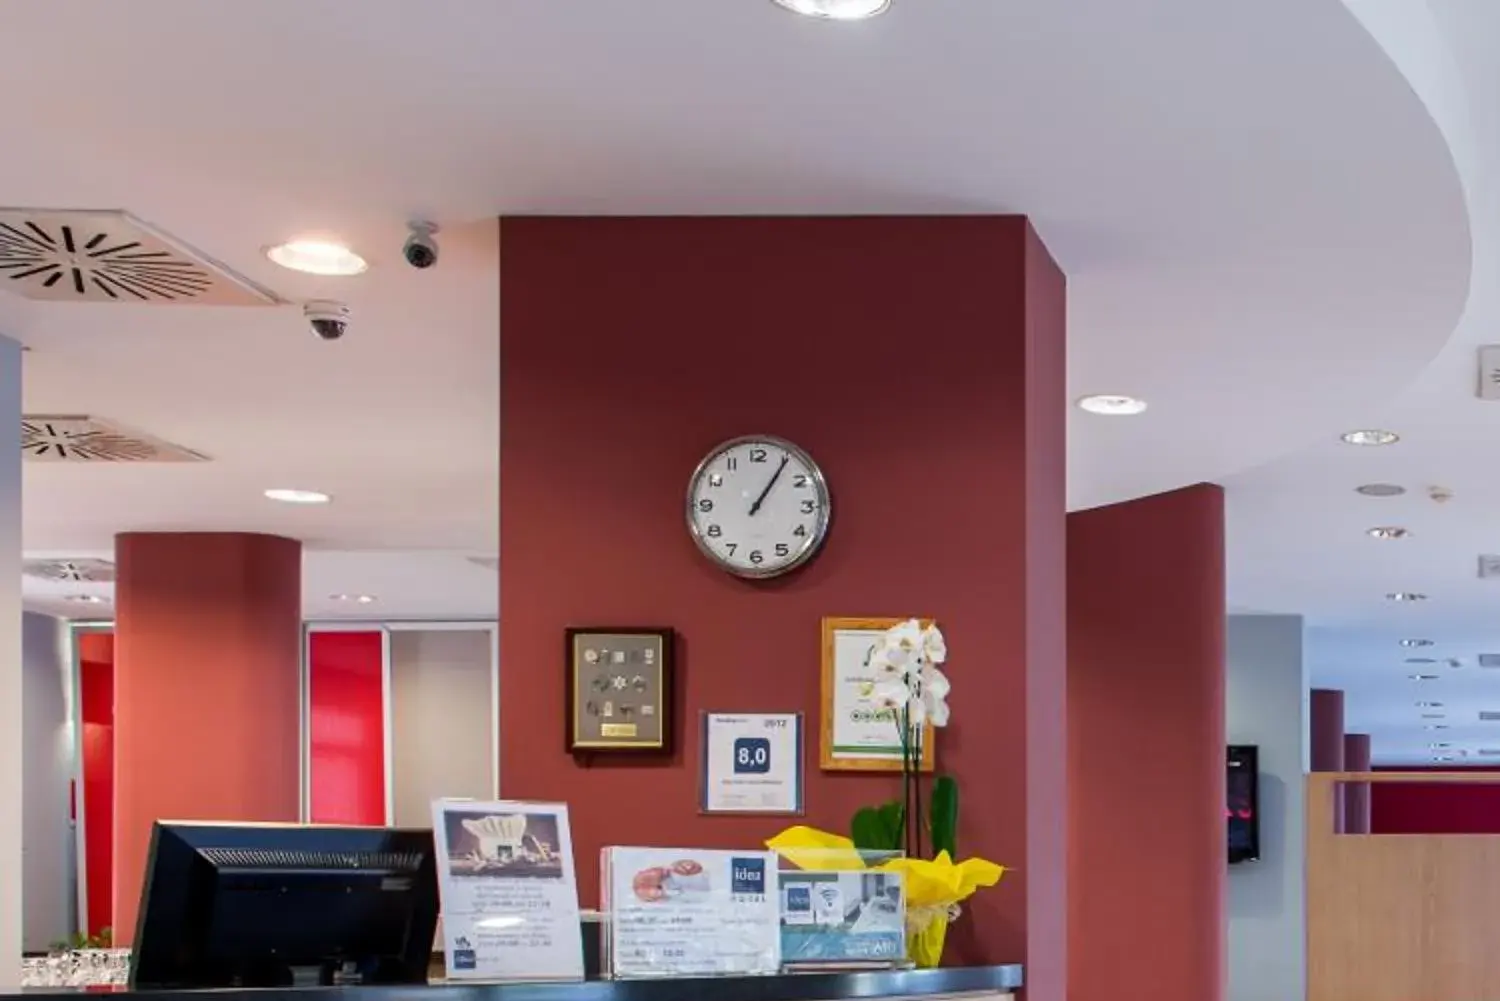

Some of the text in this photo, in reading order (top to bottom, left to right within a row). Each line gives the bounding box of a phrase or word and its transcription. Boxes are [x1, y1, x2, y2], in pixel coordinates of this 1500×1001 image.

[750, 450, 767, 463] 12
[727, 458, 737, 471] 11
[793, 475, 807, 488] 2
[700, 499, 713, 512] 9
[801, 500, 814, 514] 3
[708, 525, 721, 537] 8
[793, 524, 805, 537] 4
[726, 543, 738, 557] 7
[750, 550, 763, 563] 6
[775, 543, 789, 557] 5
[739, 747, 766, 767] 8,0
[735, 866, 761, 881] idea
